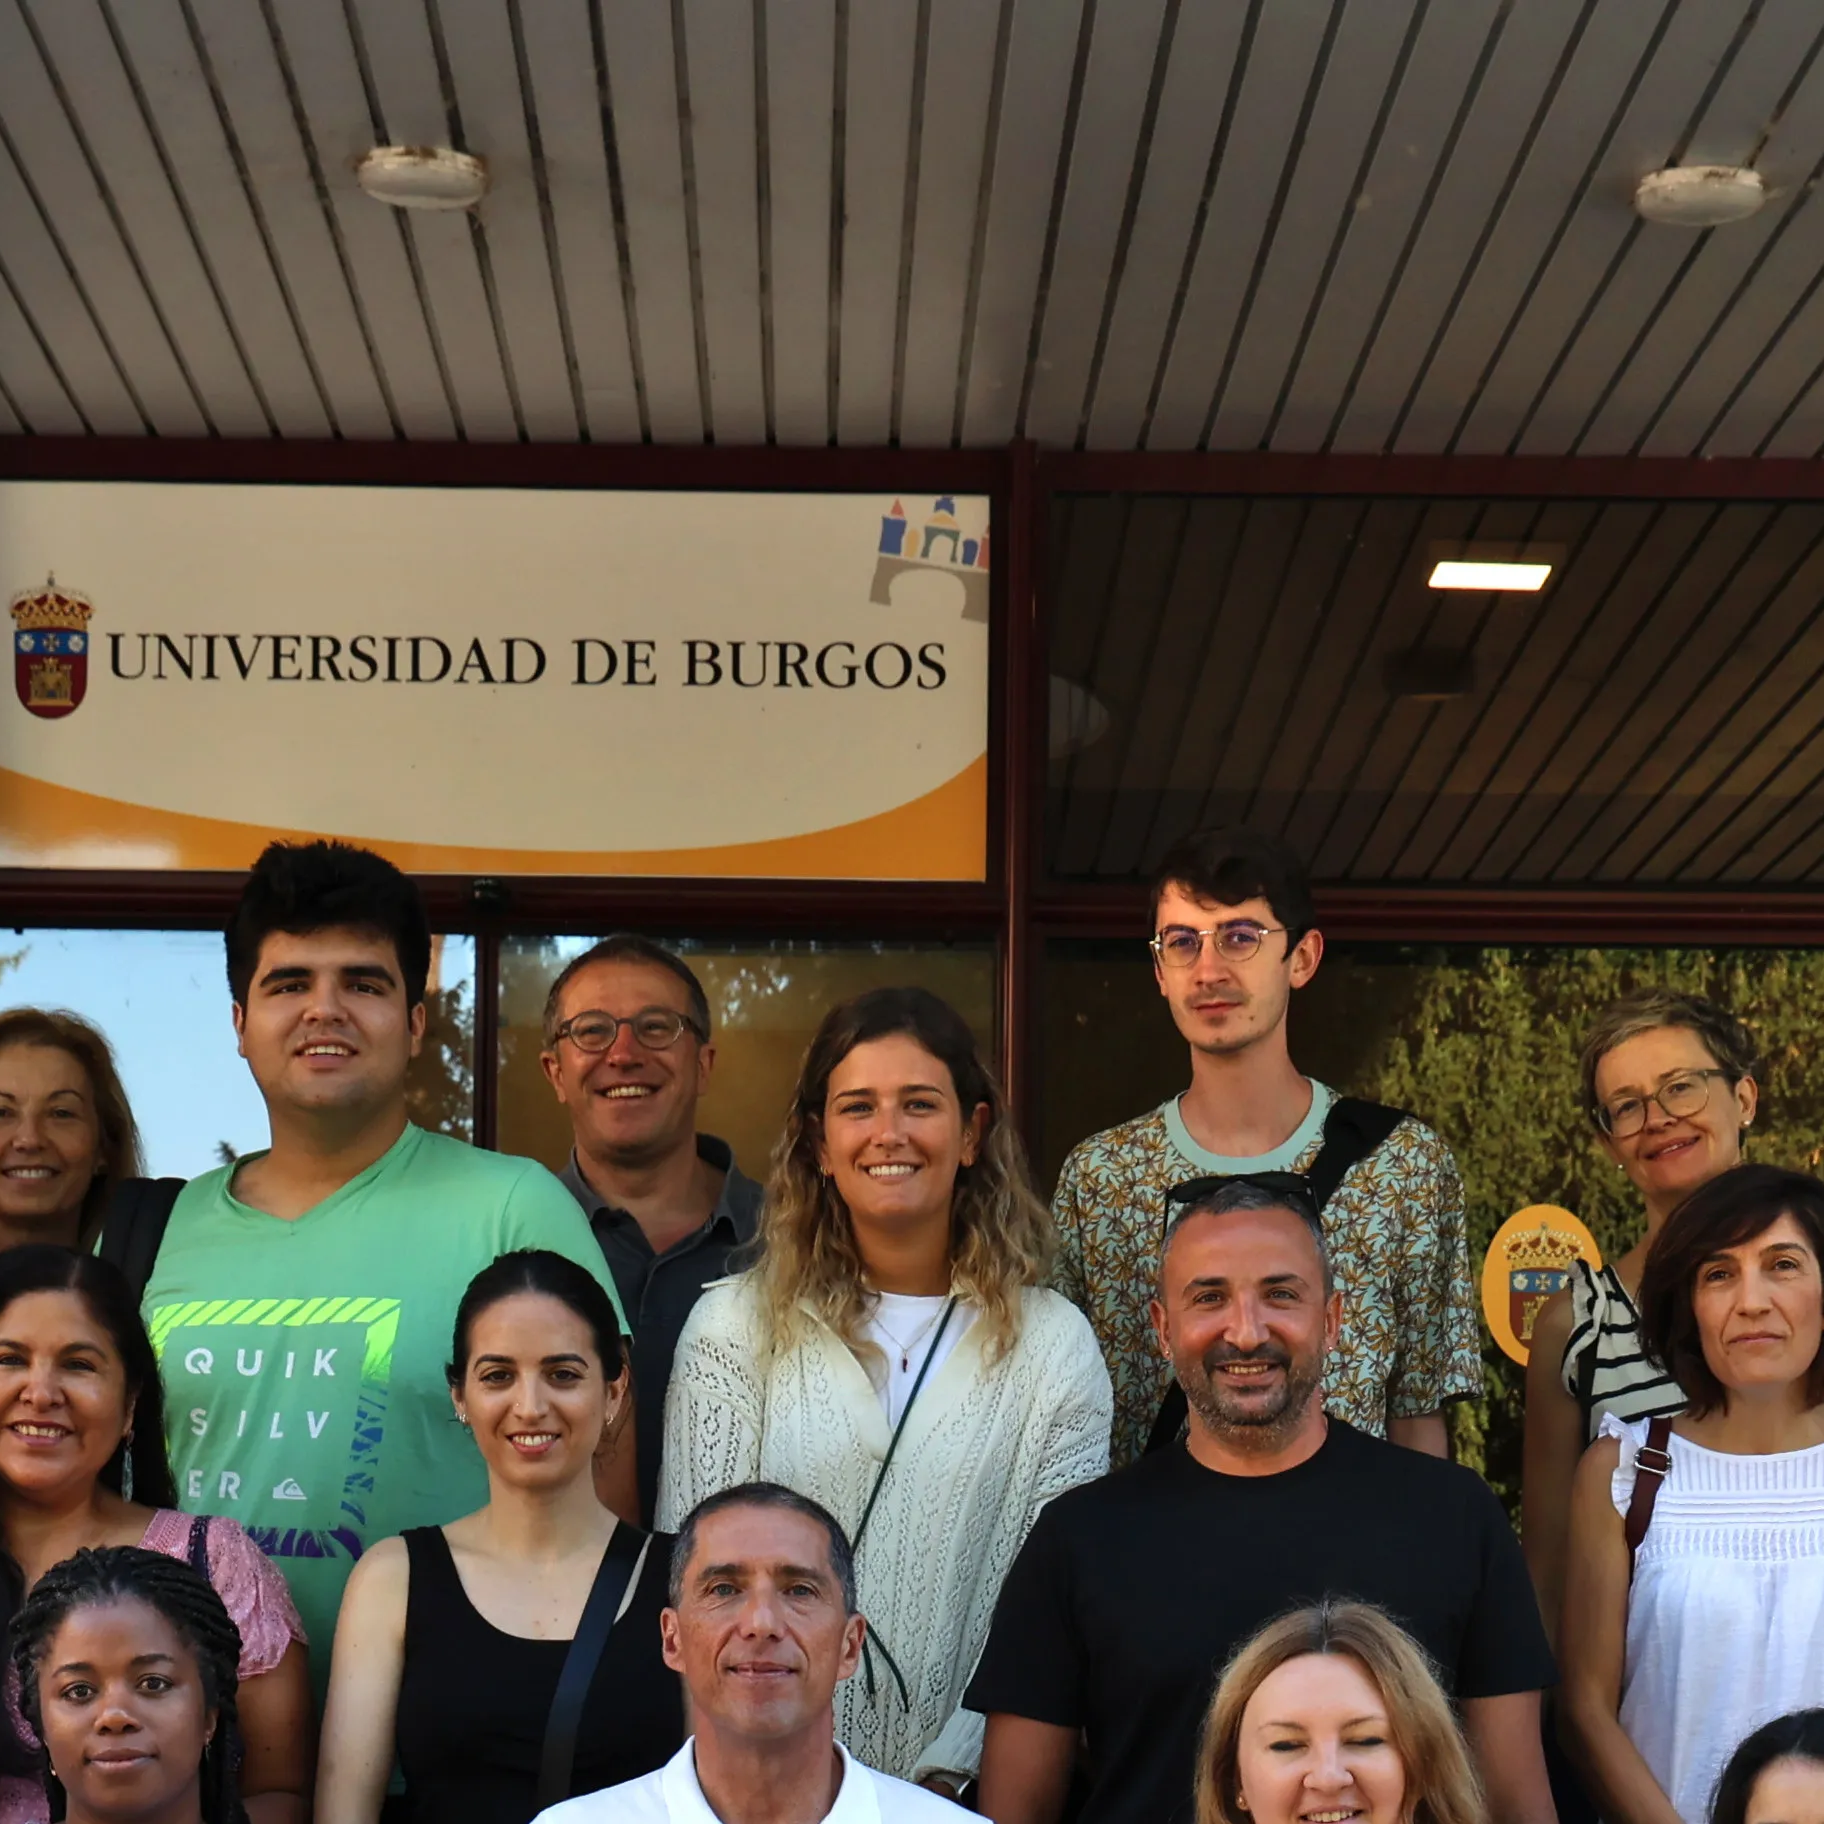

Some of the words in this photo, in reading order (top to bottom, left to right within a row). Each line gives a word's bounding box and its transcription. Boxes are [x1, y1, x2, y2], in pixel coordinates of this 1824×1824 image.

[106, 632, 547, 684] UNIVERSIDAD
[571, 638, 657, 686] DE
[681, 639, 947, 690] BURGOS
[184, 1347, 338, 1379] QUIK
[189, 1407, 330, 1440] SILV
[187, 1470, 241, 1500] ER
